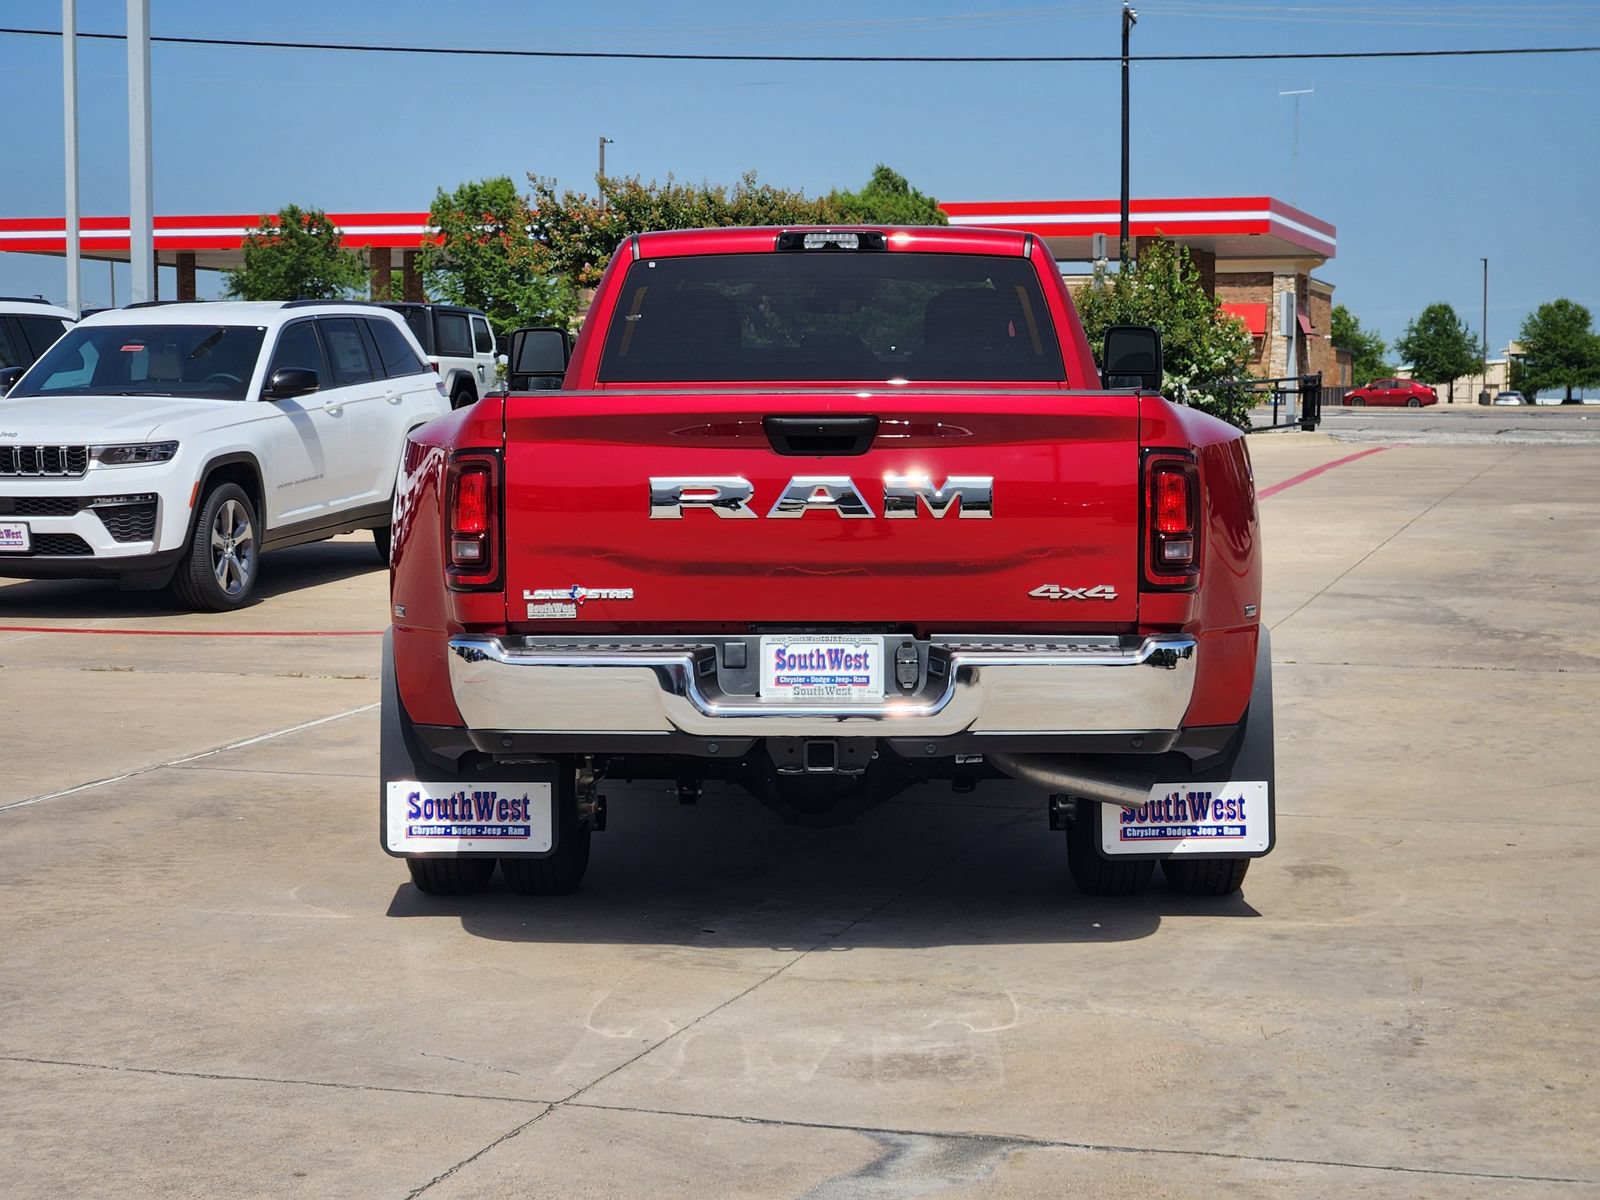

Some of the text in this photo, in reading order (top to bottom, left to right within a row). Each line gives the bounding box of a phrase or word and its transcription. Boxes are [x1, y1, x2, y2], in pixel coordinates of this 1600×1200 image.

[649, 475, 993, 519] RAM
[523, 588, 634, 600] LONE STAR
[1027, 584, 1119, 600] 4x4
[527, 602, 577, 613] SouthWest
[775, 648, 870, 672] SouthWest
[779, 676, 805, 684] Chrysler
[810, 676, 830, 684] Dodge
[835, 676, 850, 684] Jeep
[793, 686, 852, 696] SouthWest
[406, 791, 531, 822] SouthWest
[411, 825, 525, 836] Chrysler Dodge Jeep Ram
[1126, 826, 1241, 838] Chrysler Dodge Jeep Ram
